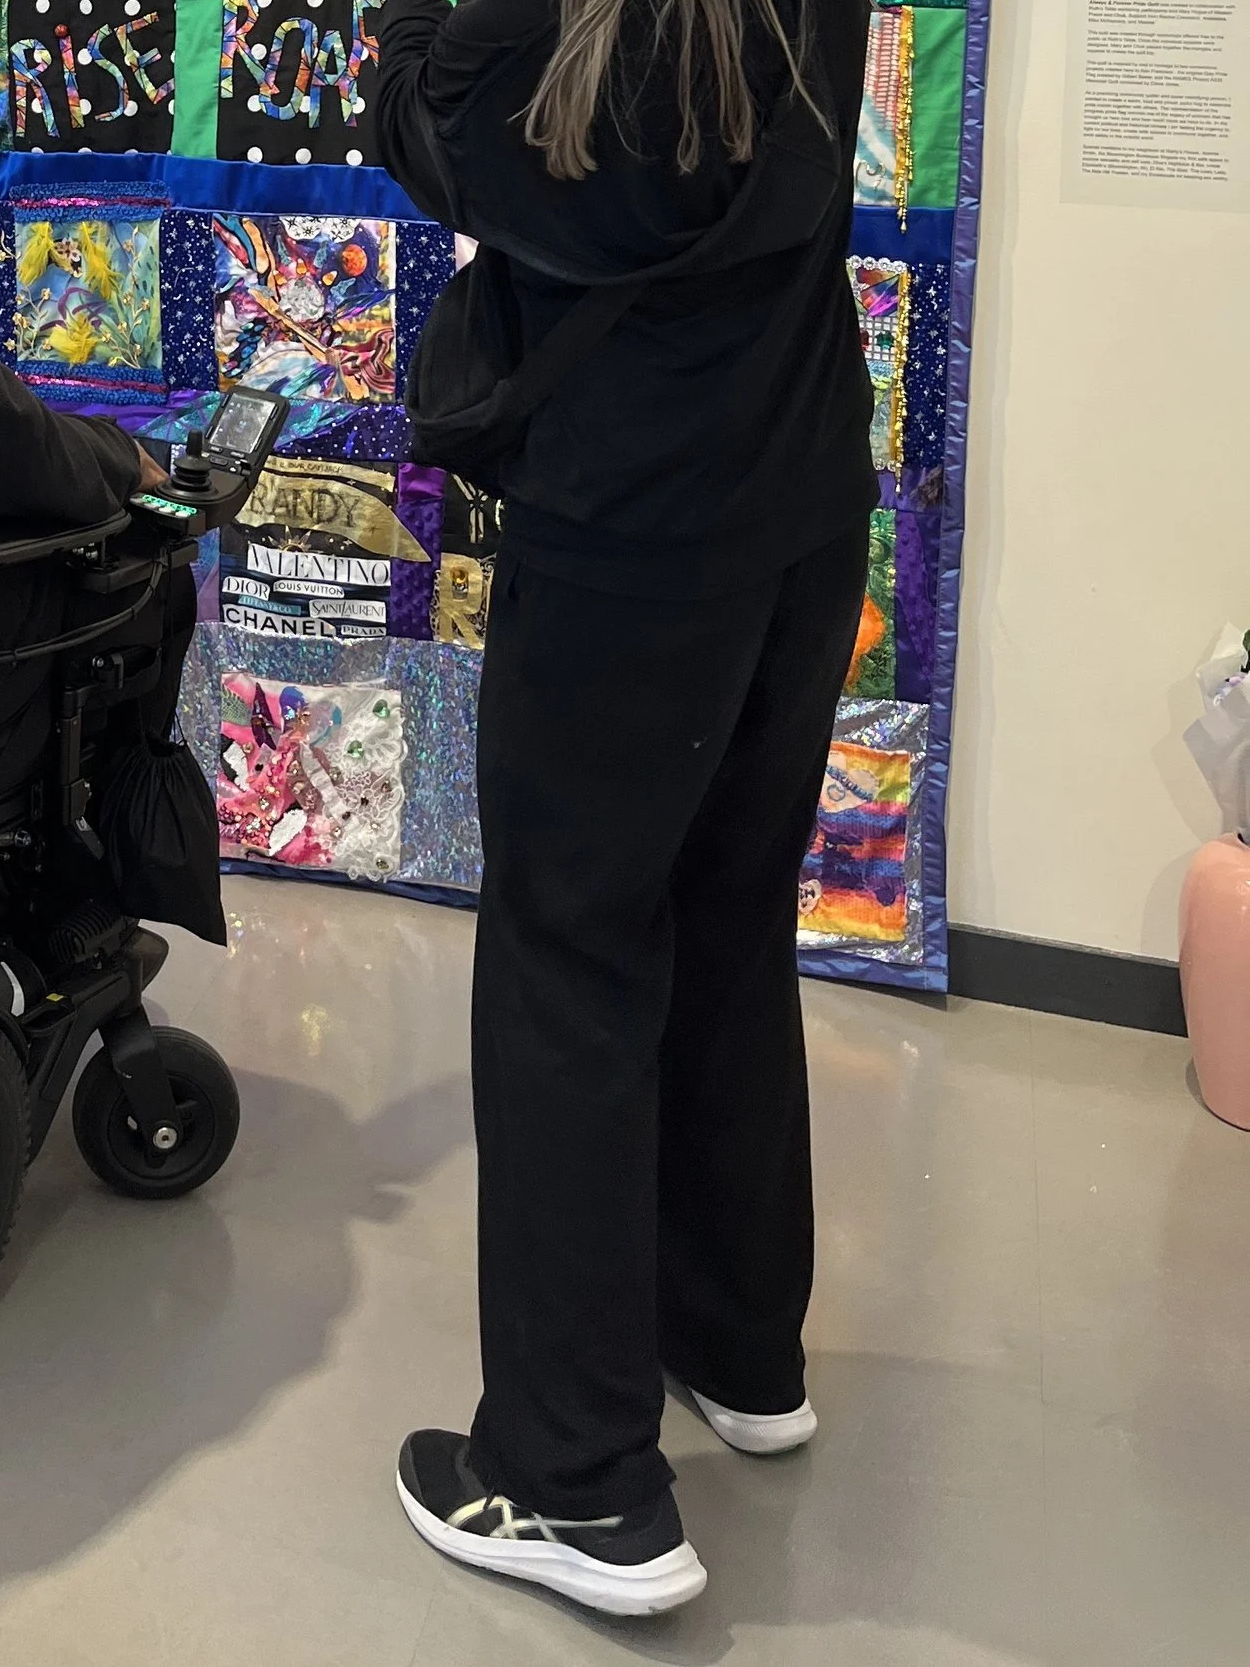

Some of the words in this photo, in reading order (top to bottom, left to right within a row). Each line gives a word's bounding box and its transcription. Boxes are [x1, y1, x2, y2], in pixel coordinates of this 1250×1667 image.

[10, 11, 175, 139] RISE
[251, 545, 390, 586] VALENTINO
[226, 577, 269, 599] DIOR
[274, 582, 302, 592] LOUIS
[304, 584, 345, 596] VUITTON
[225, 607, 335, 637] CHANEL
[342, 626, 385, 636] PRADA
